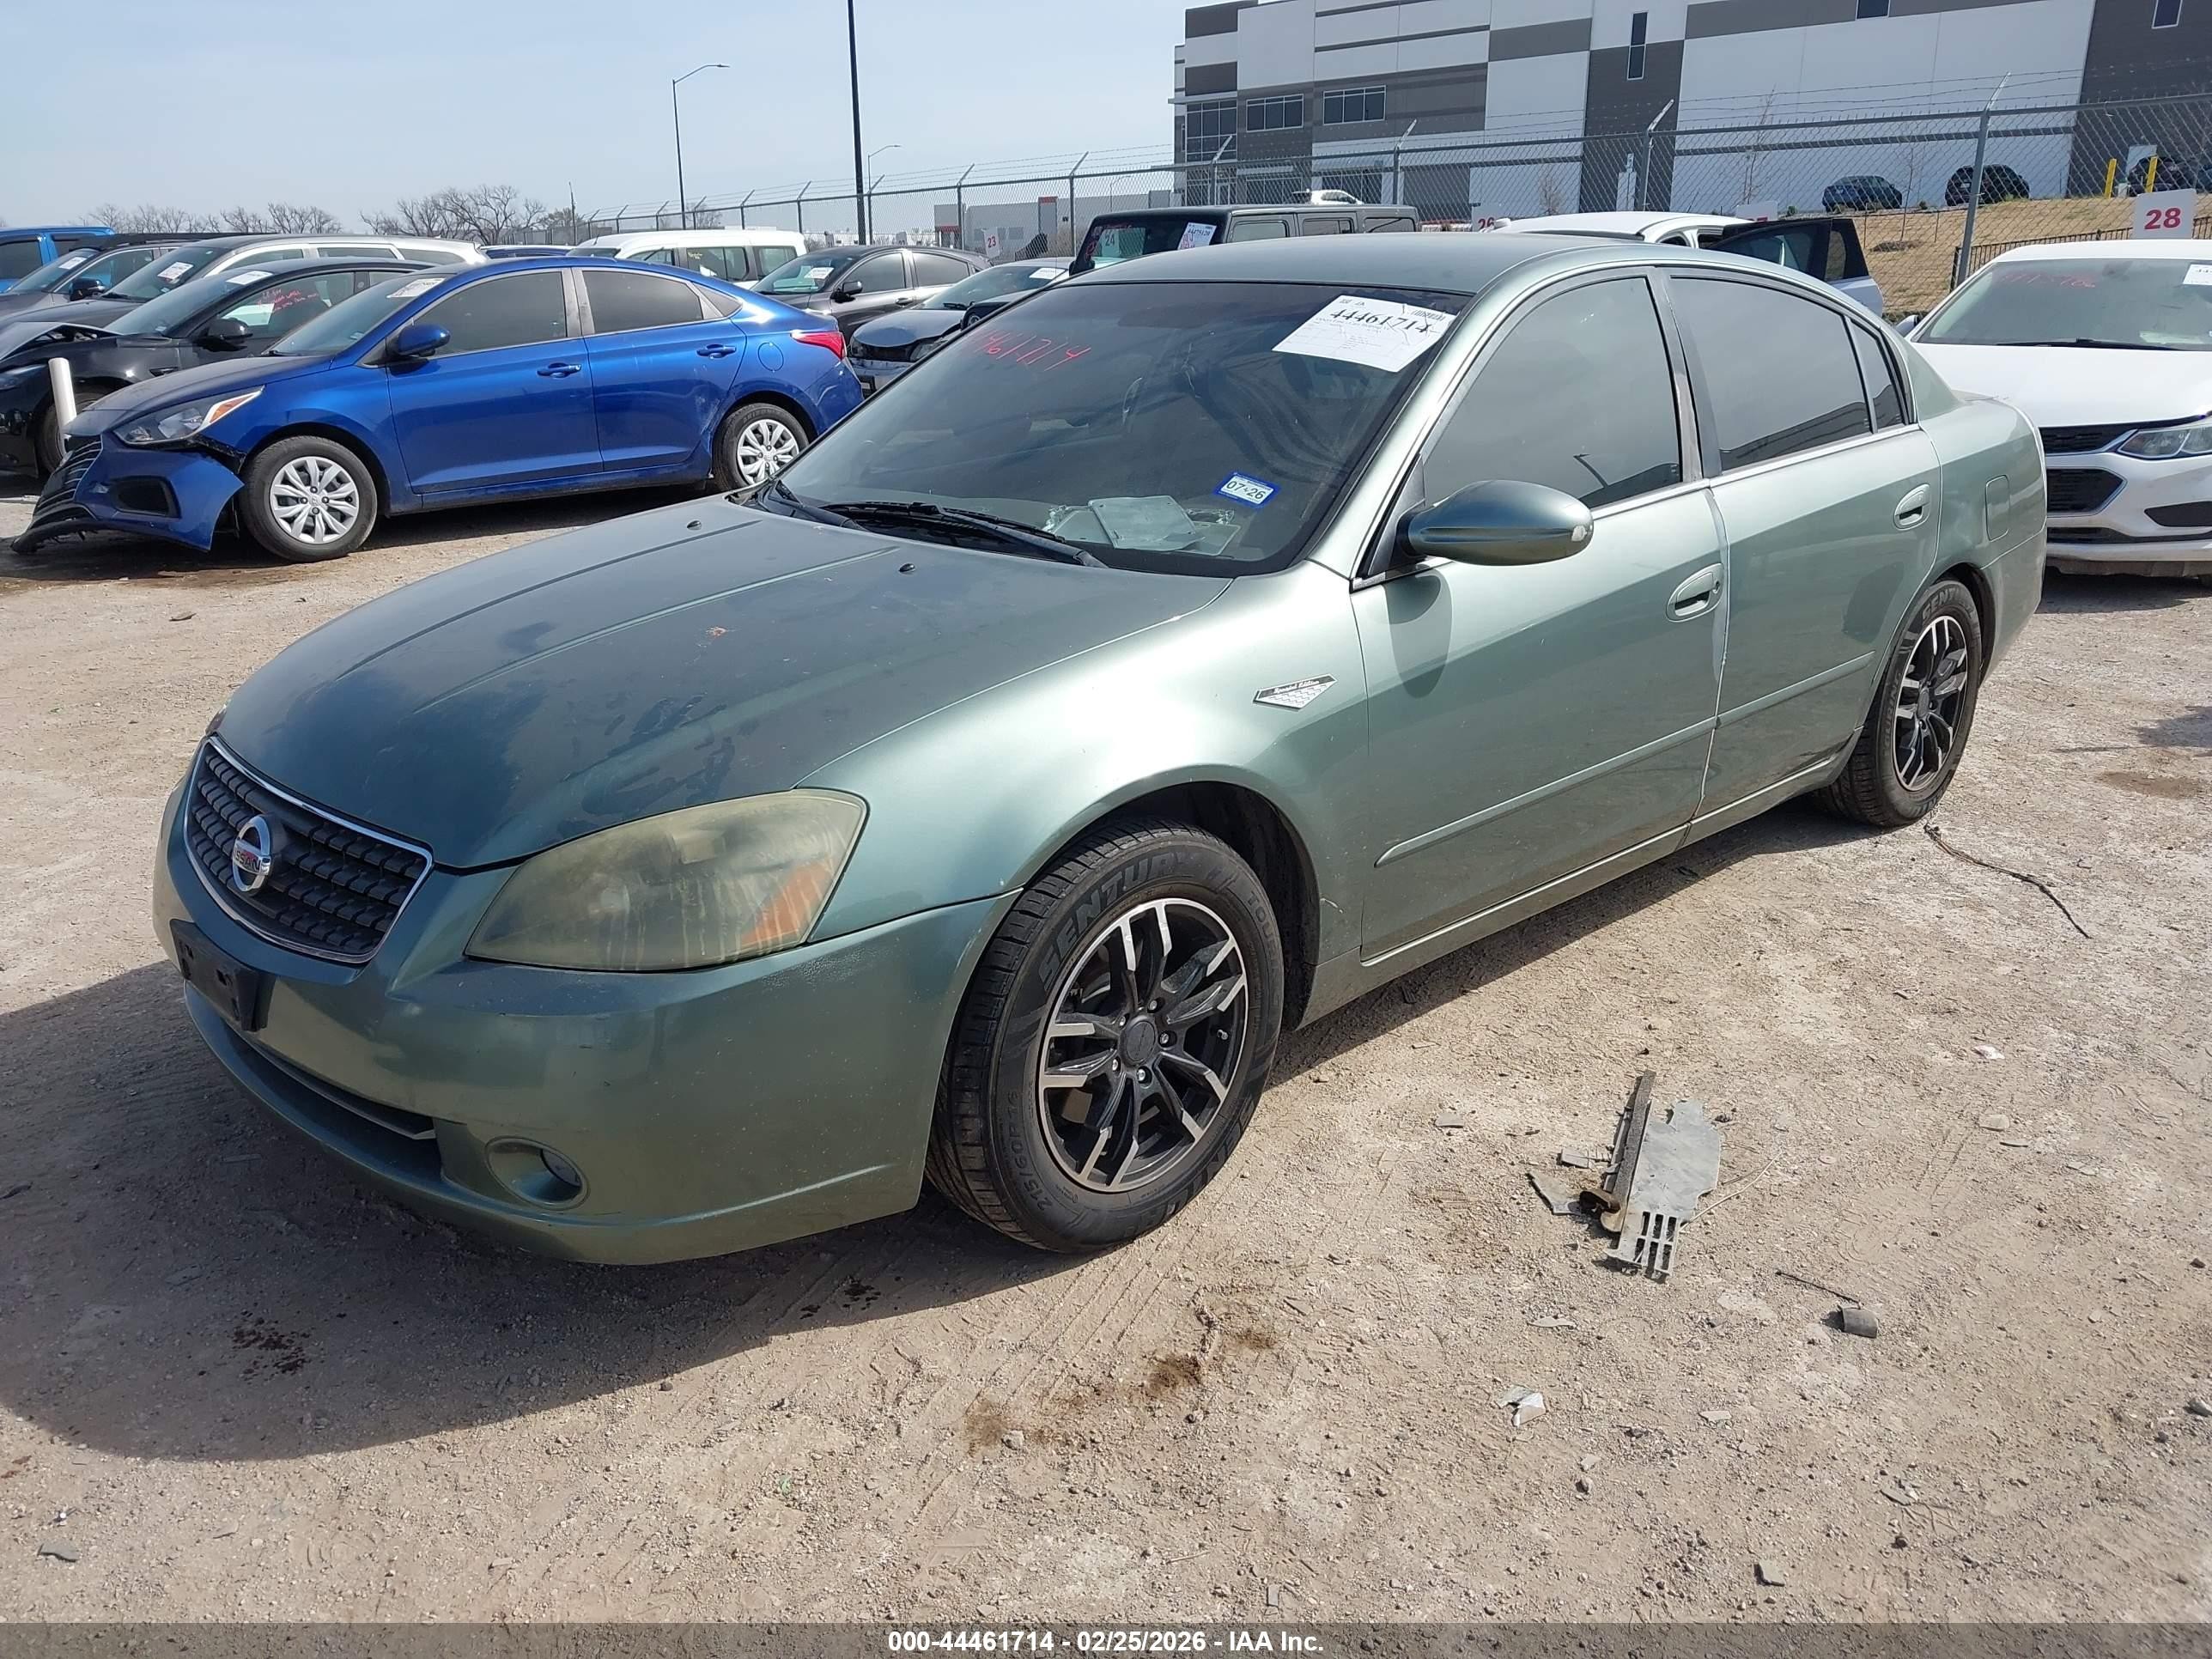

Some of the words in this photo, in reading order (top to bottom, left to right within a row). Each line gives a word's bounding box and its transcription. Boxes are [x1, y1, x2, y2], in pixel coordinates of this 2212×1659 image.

[2144, 208, 2181, 230] 28
[988, 235, 997, 248] 23
[1329, 308, 1433, 333] 44461714
